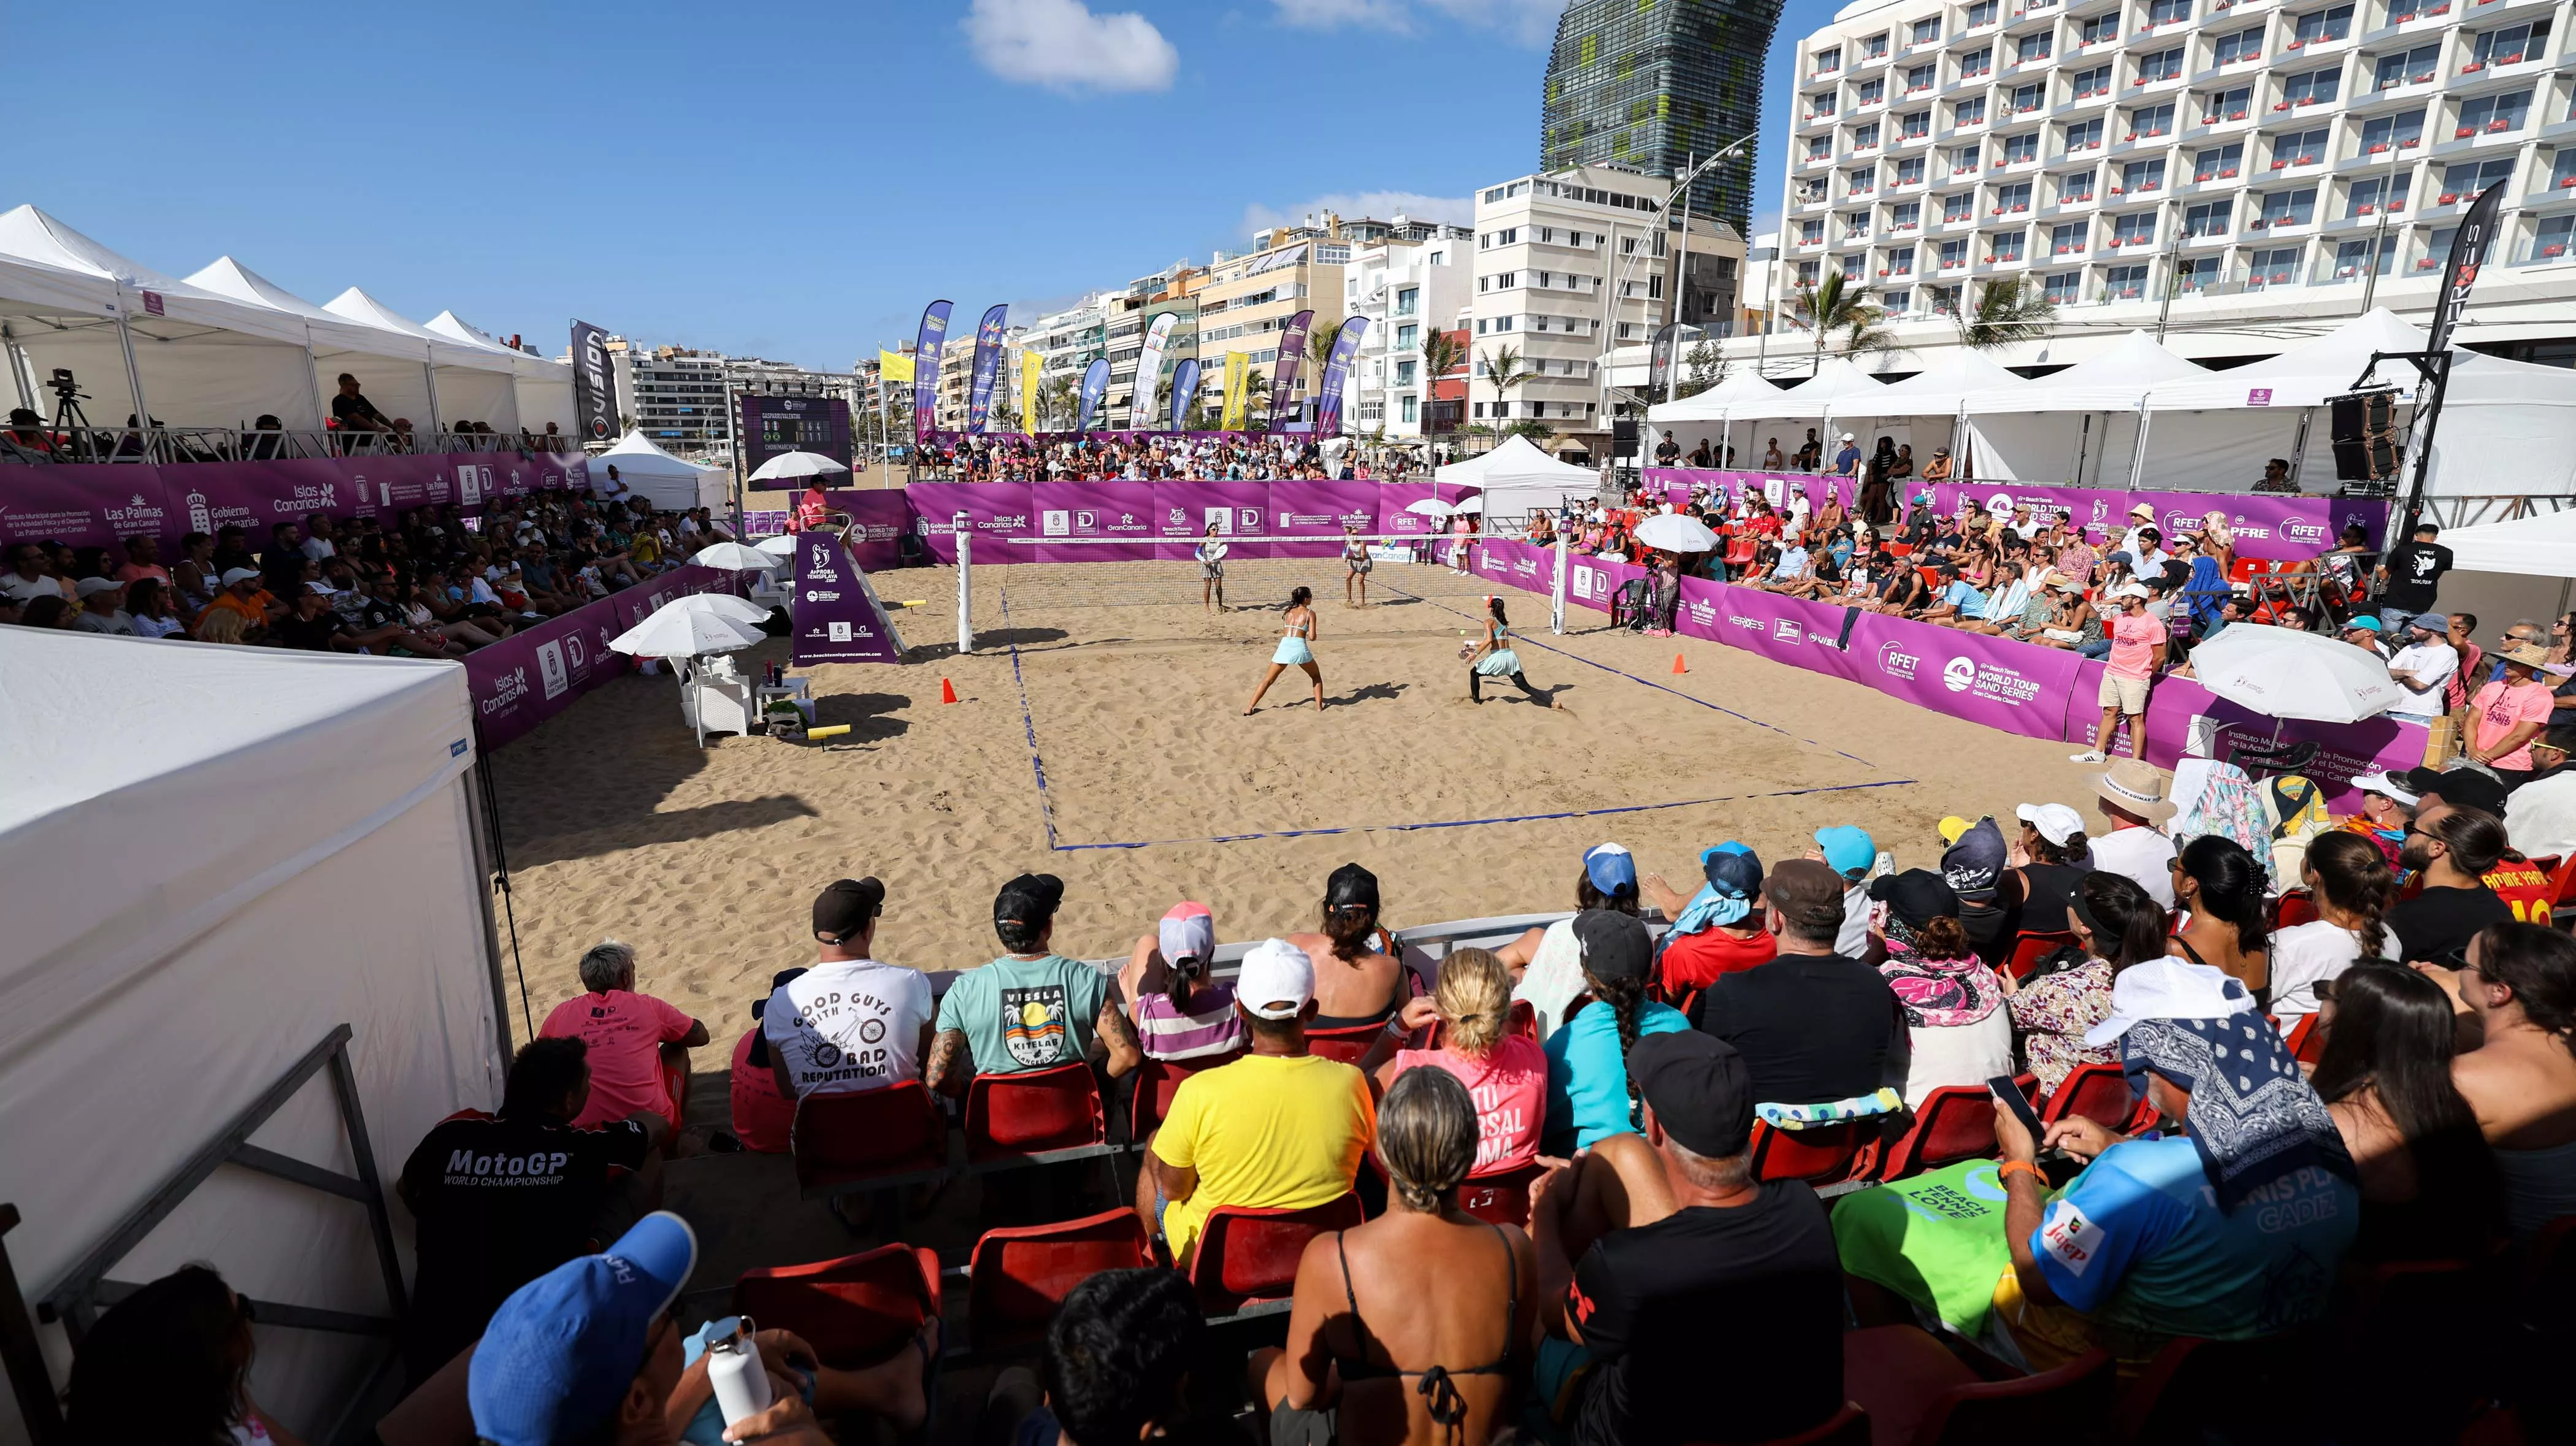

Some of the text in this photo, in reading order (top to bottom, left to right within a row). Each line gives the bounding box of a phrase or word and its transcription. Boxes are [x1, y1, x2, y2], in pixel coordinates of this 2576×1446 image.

[927, 314, 946, 323] BEACH
[1290, 325, 1305, 335] Tirma
[1283, 351, 1298, 361] Tirma
[546, 476, 558, 486] RFET
[294, 485, 318, 498] Islas
[504, 487, 529, 495] GranCanaria
[274, 498, 320, 512] Canarias
[2049, 505, 2072, 515] TOUR
[104, 507, 163, 520] Las Palmas
[212, 506, 249, 519] Gobierno
[139, 518, 160, 527] Canaria
[1397, 517, 1417, 526] RFET
[2173, 518, 2201, 528] RFET
[15, 527, 25, 537] Las
[2291, 525, 2325, 537] RFET
[1369, 551, 1414, 560] ranCanaria
[1699, 604, 1716, 614] Palmas
[1779, 621, 1799, 635] Tirma
[1888, 651, 1920, 670] RFET
[494, 673, 513, 692] Islas
[1978, 670, 2040, 692] WORLD TOUR
[1975, 679, 2034, 701] SAND SERIES
[483, 687, 516, 714] Canarias
[1984, 692, 2002, 702] Canaria
[2003, 697, 2020, 706] Classic
[2228, 730, 2259, 743] Instituto
[2333, 754, 2381, 770] Promoción
[2328, 762, 2365, 776] Deporte
[1007, 990, 1061, 1002] VISSLA
[793, 992, 892, 1028] GOOD GUYS
[807, 1007, 840, 1029] WITH
[1014, 1038, 1059, 1050] KITELAB
[846, 1048, 887, 1065] BAD
[802, 1064, 886, 1084] REPUTATION
[444, 1175, 564, 1187] WORLD CHAMPIONSHIP
[1907, 1190, 1963, 1219] LOVE
[1922, 1187, 1978, 1218] TENNIS
[1933, 1185, 1991, 1215] BEACH
[2256, 1190, 2337, 1234] CADIZ
